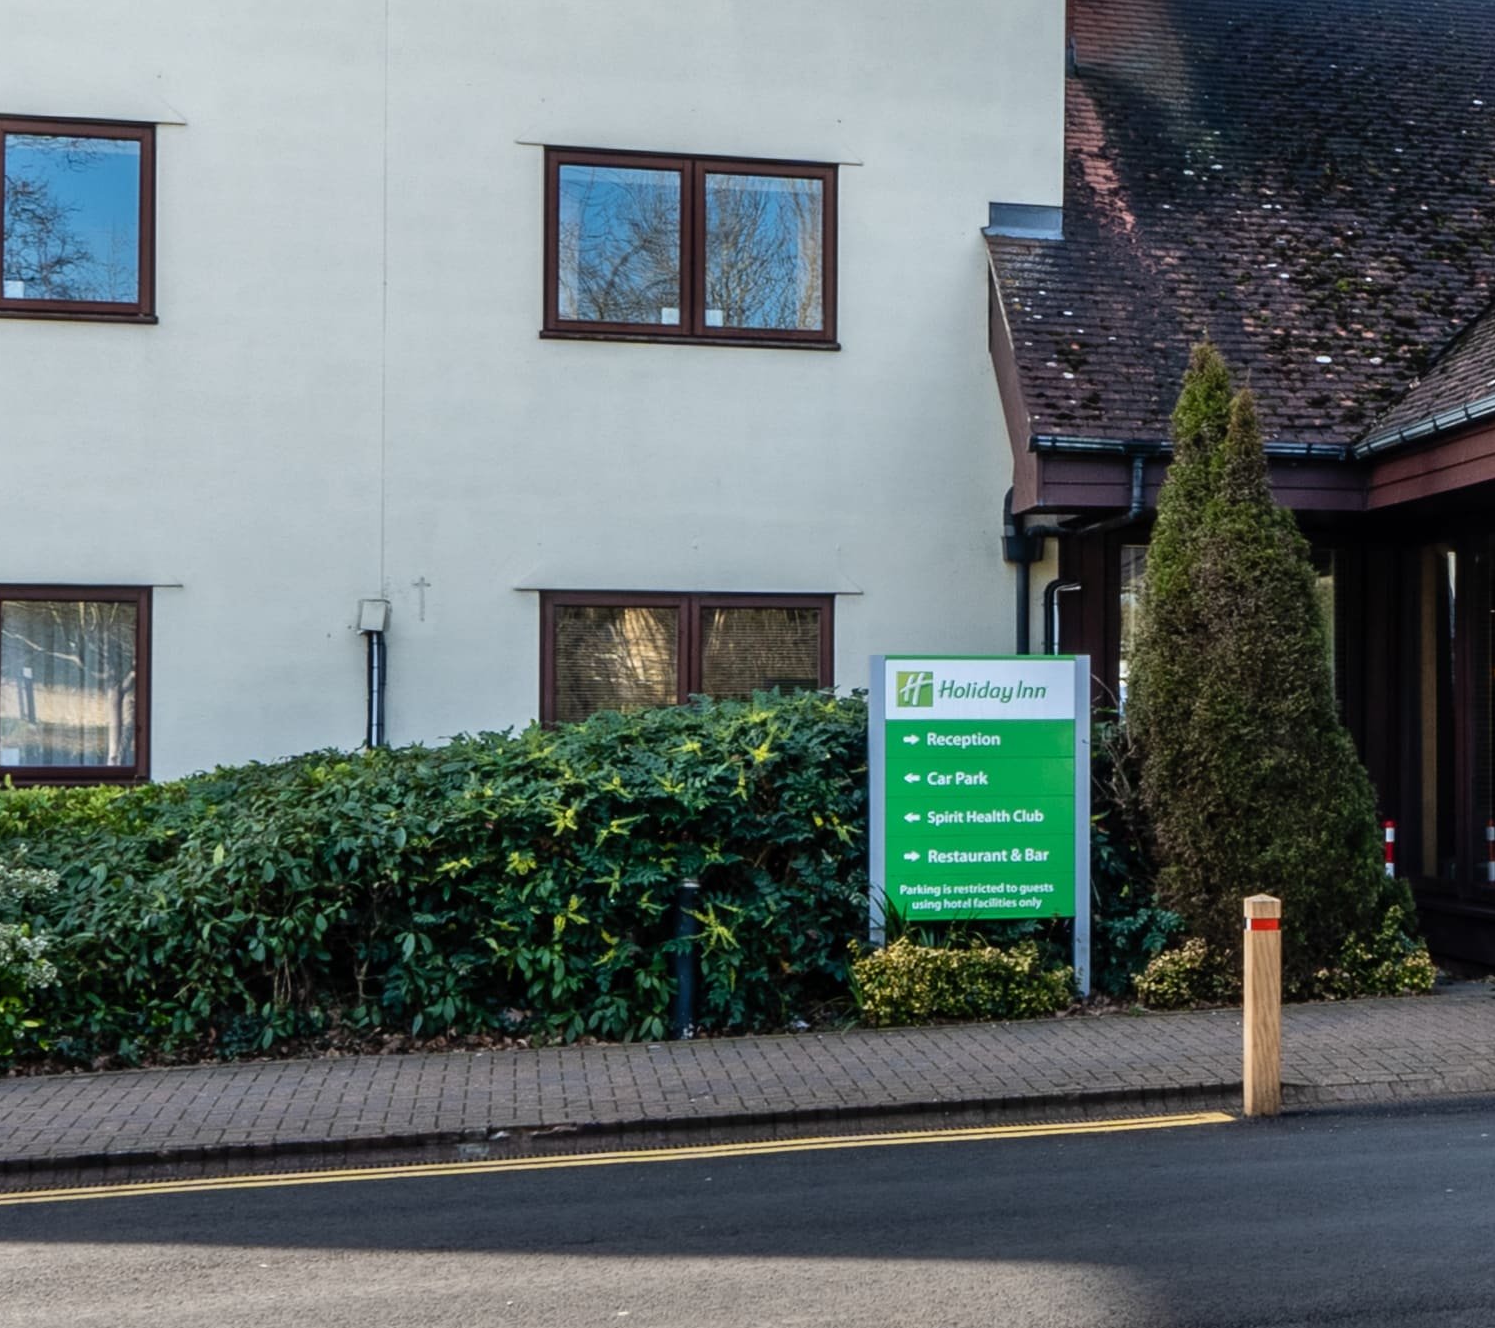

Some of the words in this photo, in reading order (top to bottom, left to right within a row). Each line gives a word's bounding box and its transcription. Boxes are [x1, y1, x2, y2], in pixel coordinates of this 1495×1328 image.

[938, 680, 1013, 704] Holiday
[1016, 680, 1047, 699] Inn
[926, 731, 1001, 749] Reception
[926, 771, 952, 785] Car
[955, 770, 989, 785] Park
[927, 810, 964, 826] Spirit
[966, 809, 1010, 823] Health
[1013, 809, 1045, 823] Club
[928, 849, 1007, 863] Restaurant
[1010, 848, 1022, 862] &
[1024, 848, 1049, 862] Bar
[899, 884, 942, 897] Parking
[943, 883, 952, 894] is
[953, 883, 1004, 894] restricted
[1006, 883, 1018, 894] to
[1019, 883, 1054, 895] guests
[912, 899, 942, 911] using
[943, 898, 971, 910] hotel
[973, 897, 1017, 909] facilities
[1019, 897, 1042, 910] only
